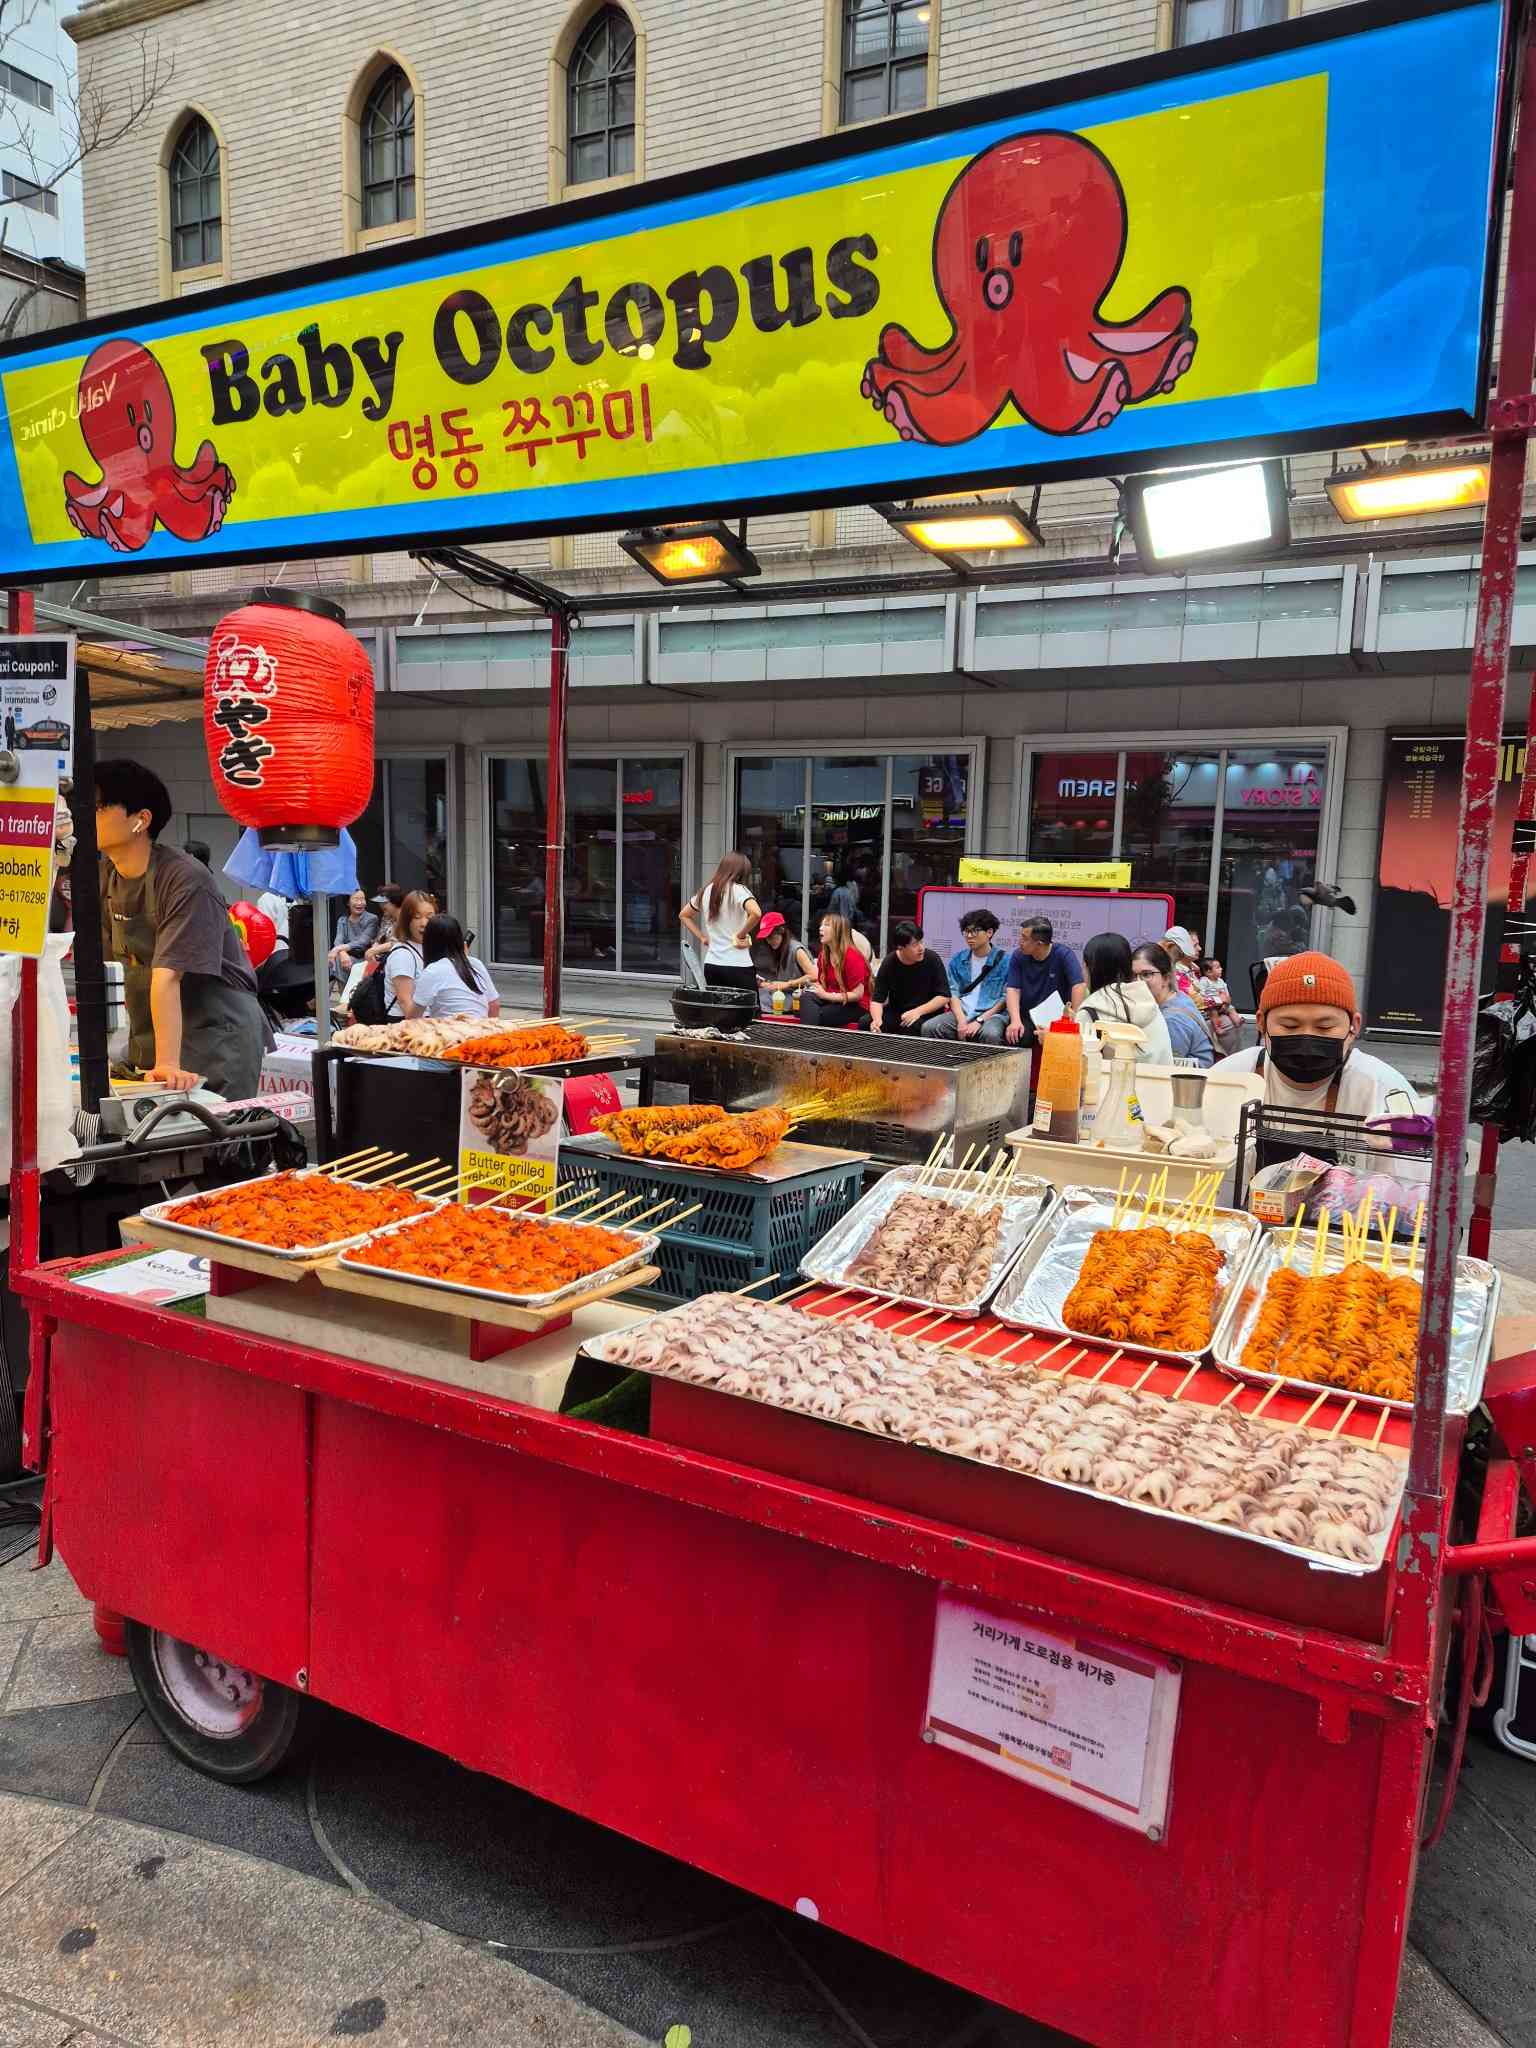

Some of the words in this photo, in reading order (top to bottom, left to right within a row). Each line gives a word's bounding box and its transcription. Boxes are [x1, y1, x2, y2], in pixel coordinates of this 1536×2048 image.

[200, 322, 405, 425] Baby
[433, 232, 881, 386] Octopus
[387, 407, 485, 491] 명동
[502, 382, 653, 468] 쭈꾸미
[11, 660, 55, 676] Coupon!
[8, 815, 52, 836] tranfer
[469, 1152, 505, 1170] Butter
[508, 1161, 545, 1179] grilled
[972, 1621, 1021, 1651] 거리가게
[1023, 1640, 1074, 1670] 도로점용
[1076, 1660, 1117, 1687] 허가증
